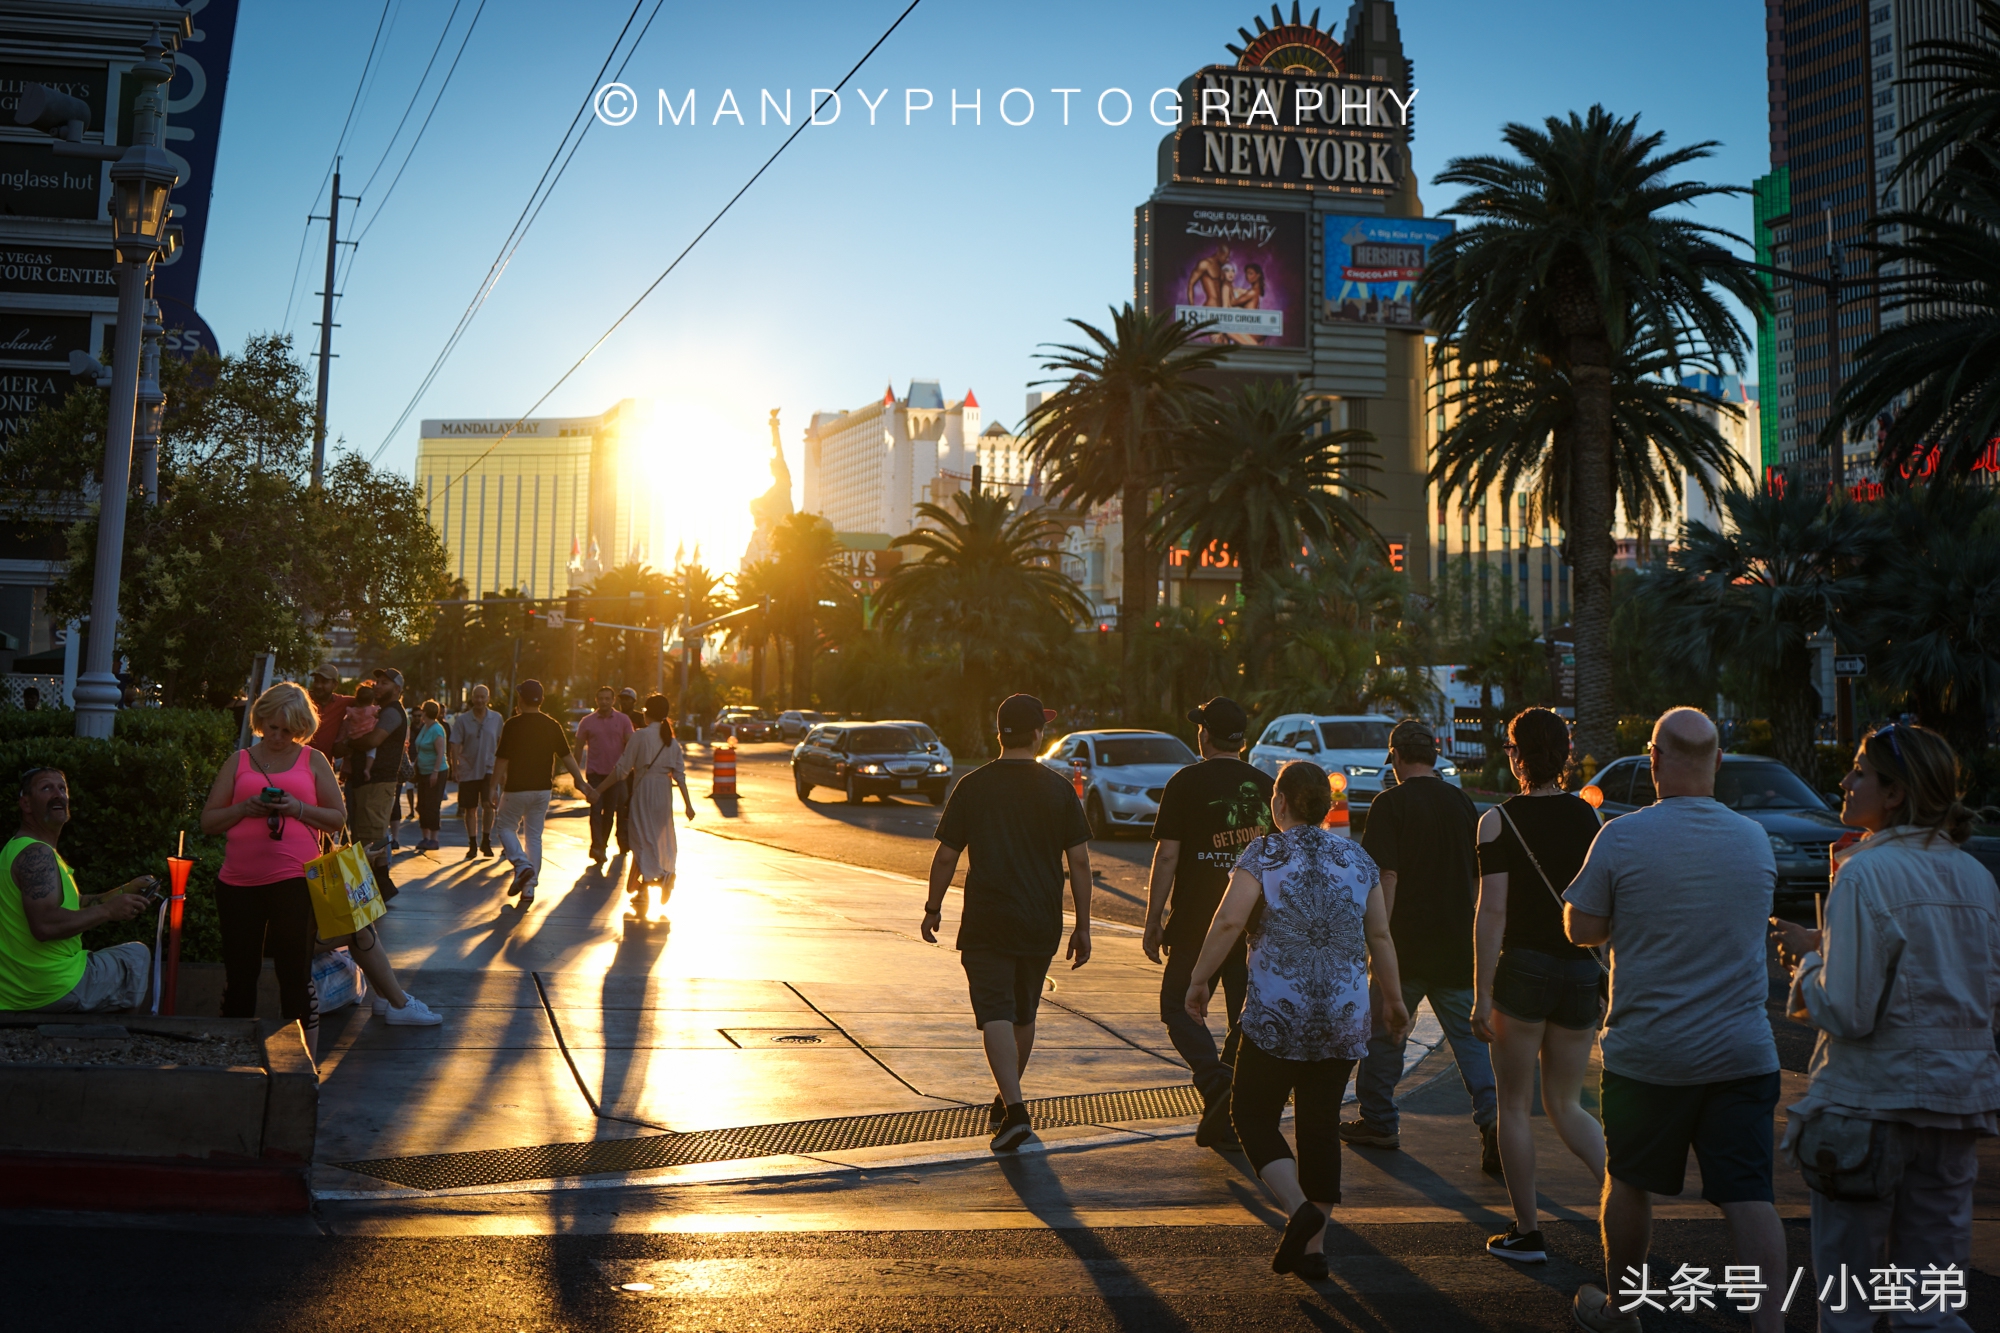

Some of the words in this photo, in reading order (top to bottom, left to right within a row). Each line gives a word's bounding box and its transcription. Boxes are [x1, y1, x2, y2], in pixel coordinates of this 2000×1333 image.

[1203, 73, 1287, 119] NEW
[1296, 80, 1394, 128] YORK
[1203, 131, 1288, 177] NEW
[1295, 137, 1394, 185] YORK
[62, 171, 94, 190] hut
[1193, 210, 1225, 222] CIRQUE
[1226, 212, 1239, 220] DU
[1240, 213, 1269, 223] SOLEIL
[1377, 229, 1391, 239] Big
[1409, 231, 1423, 240] For
[6, 252, 52, 265] VEGAS
[1356, 245, 1420, 268] HERSHEY'S
[46, 267, 116, 285] CENTER
[1346, 269, 1399, 279] CHOCOLATE
[441, 422, 513, 435] MANDALAY
[516, 423, 540, 434] BAY
[1213, 830, 1234, 849] GET
